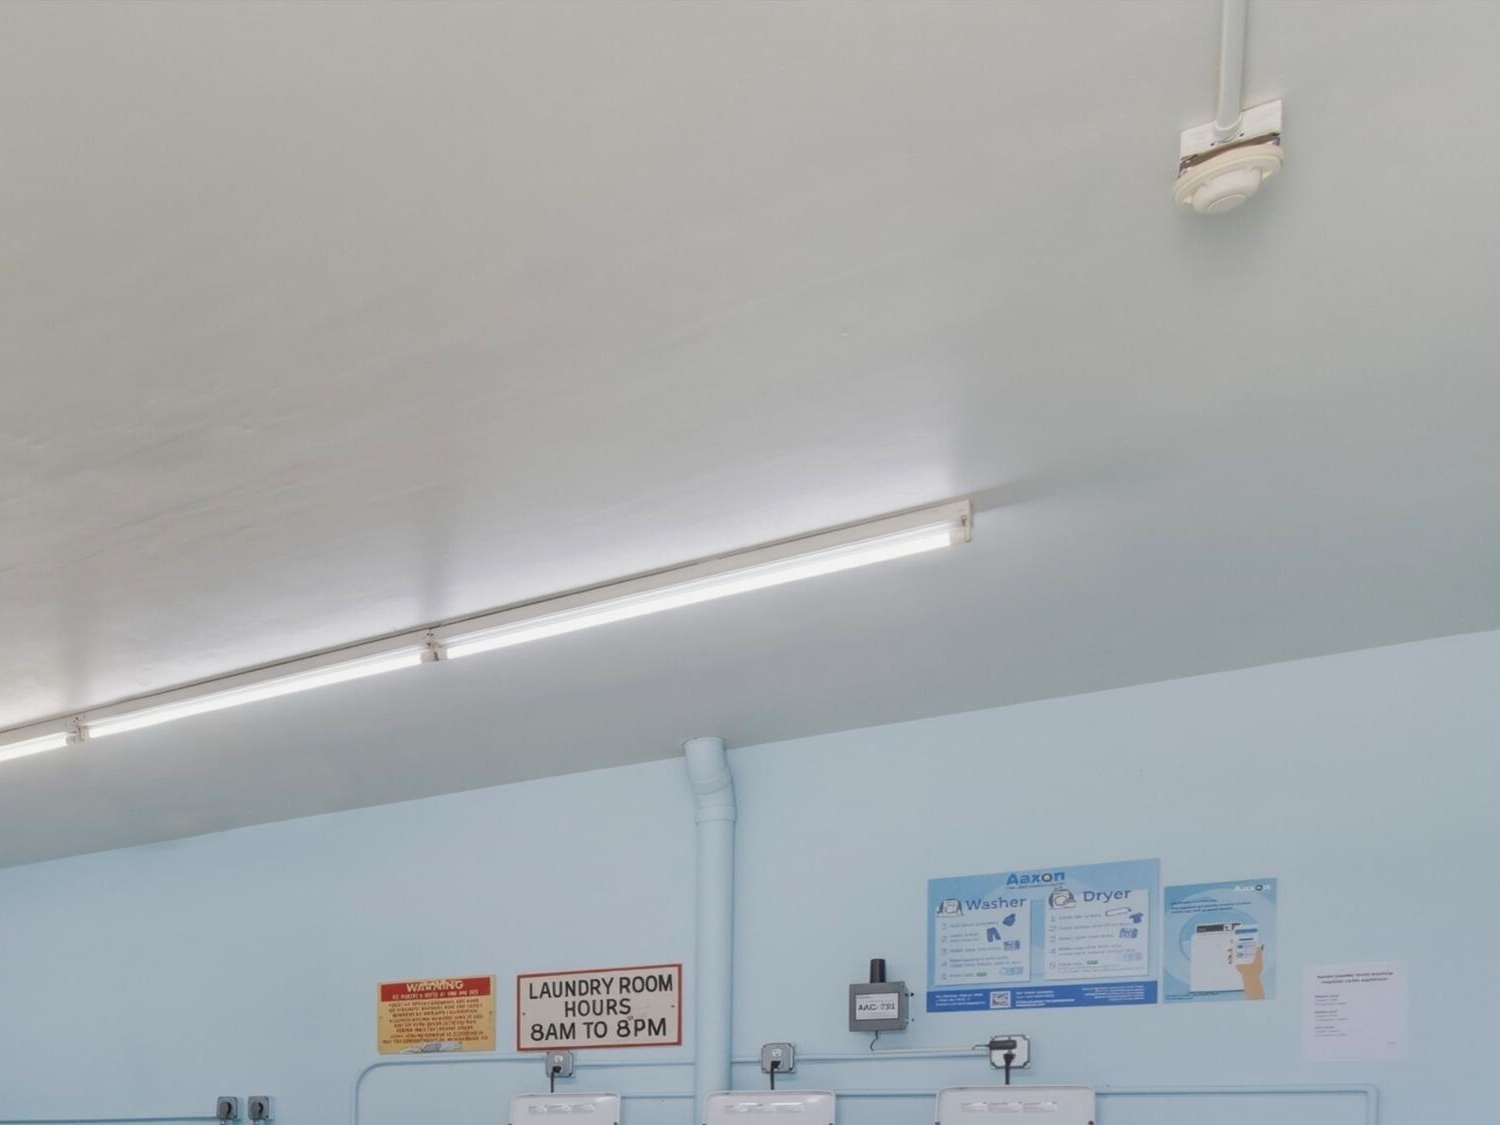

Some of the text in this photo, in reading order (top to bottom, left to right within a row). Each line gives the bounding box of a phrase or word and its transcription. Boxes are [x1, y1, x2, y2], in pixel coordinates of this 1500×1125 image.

[1006, 871, 1066, 886] Aaxon
[1083, 889, 1132, 903] Dryer
[965, 897, 1027, 911] Washer
[406, 980, 464, 992] WARNING
[529, 974, 673, 999] LAUNDRY ROOM
[564, 998, 631, 1017] HOURS
[530, 1018, 667, 1041] 8AM TO 8PM
